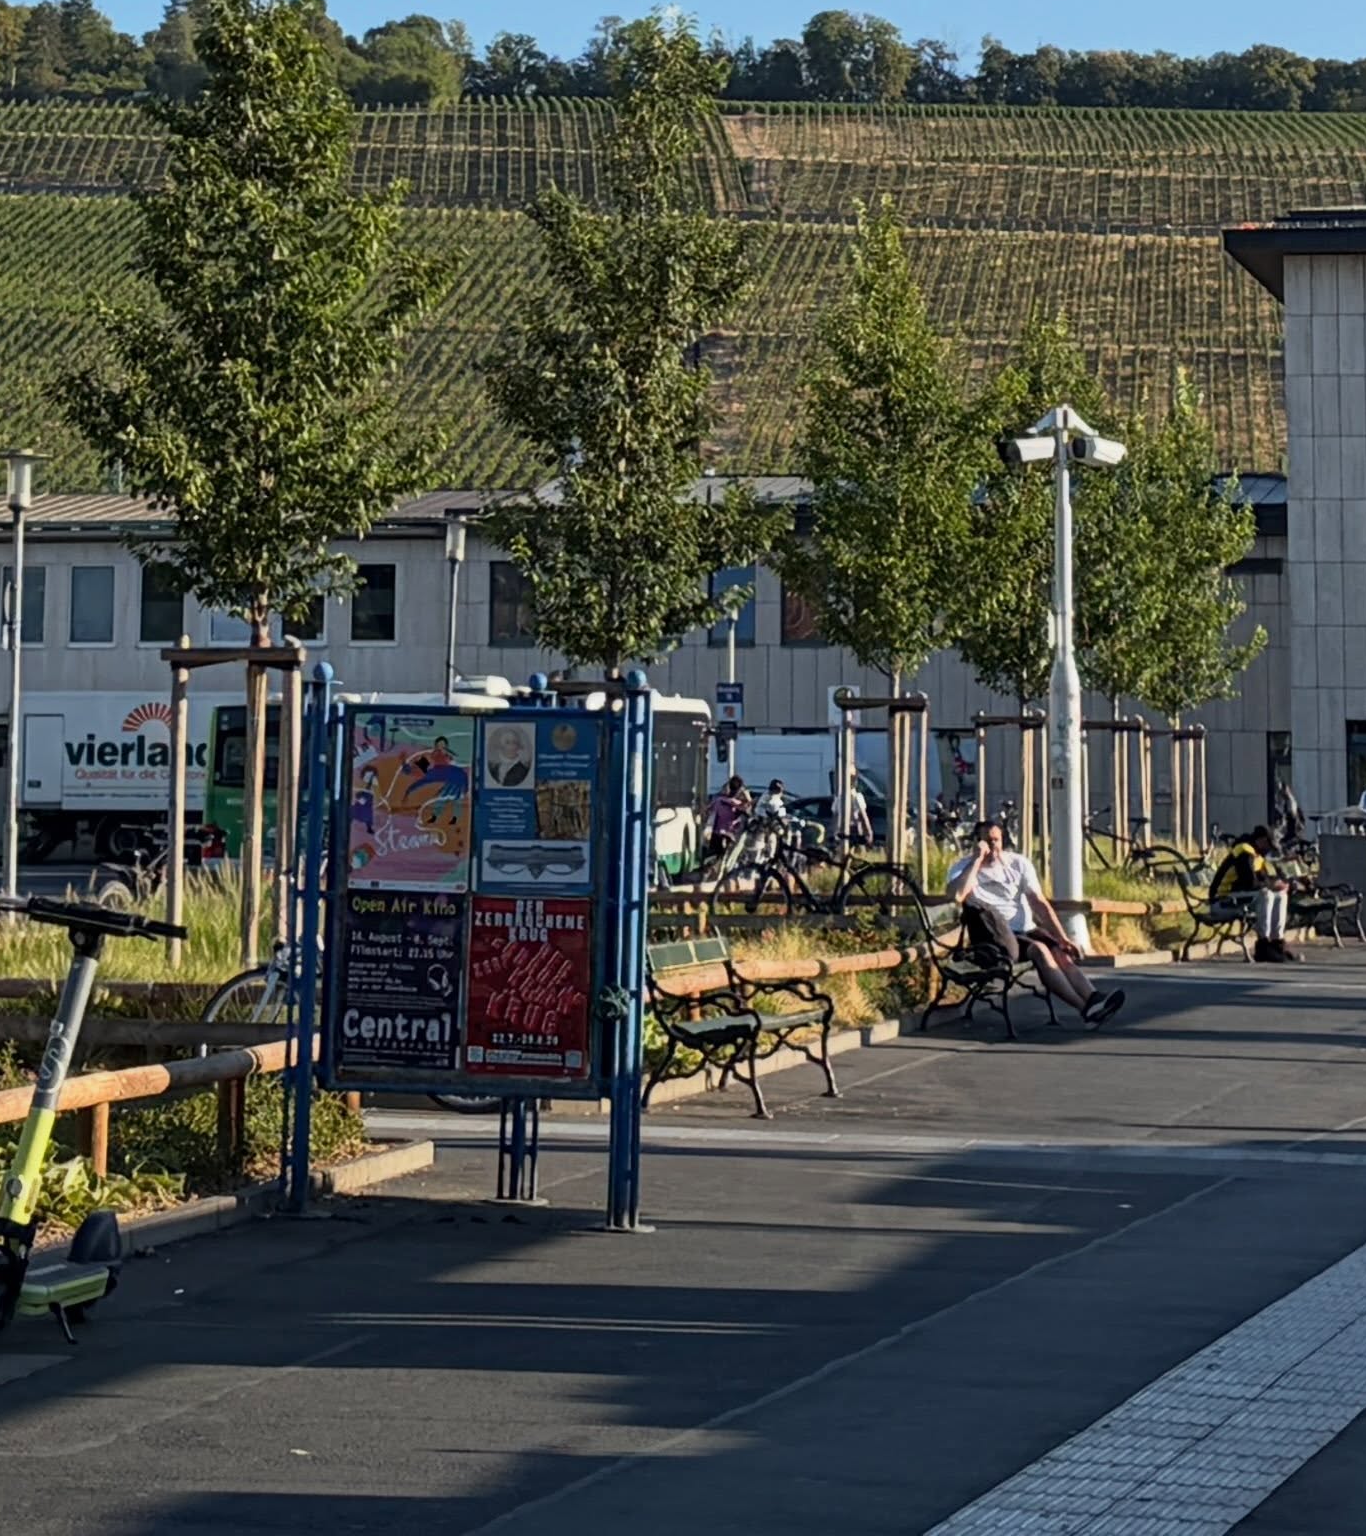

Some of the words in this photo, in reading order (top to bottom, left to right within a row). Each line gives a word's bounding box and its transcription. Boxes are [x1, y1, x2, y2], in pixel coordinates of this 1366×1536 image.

[352, 896, 385, 914] Open
[391, 897, 417, 913] Air
[423, 899, 456, 915] Kino
[343, 1009, 452, 1042] Central
